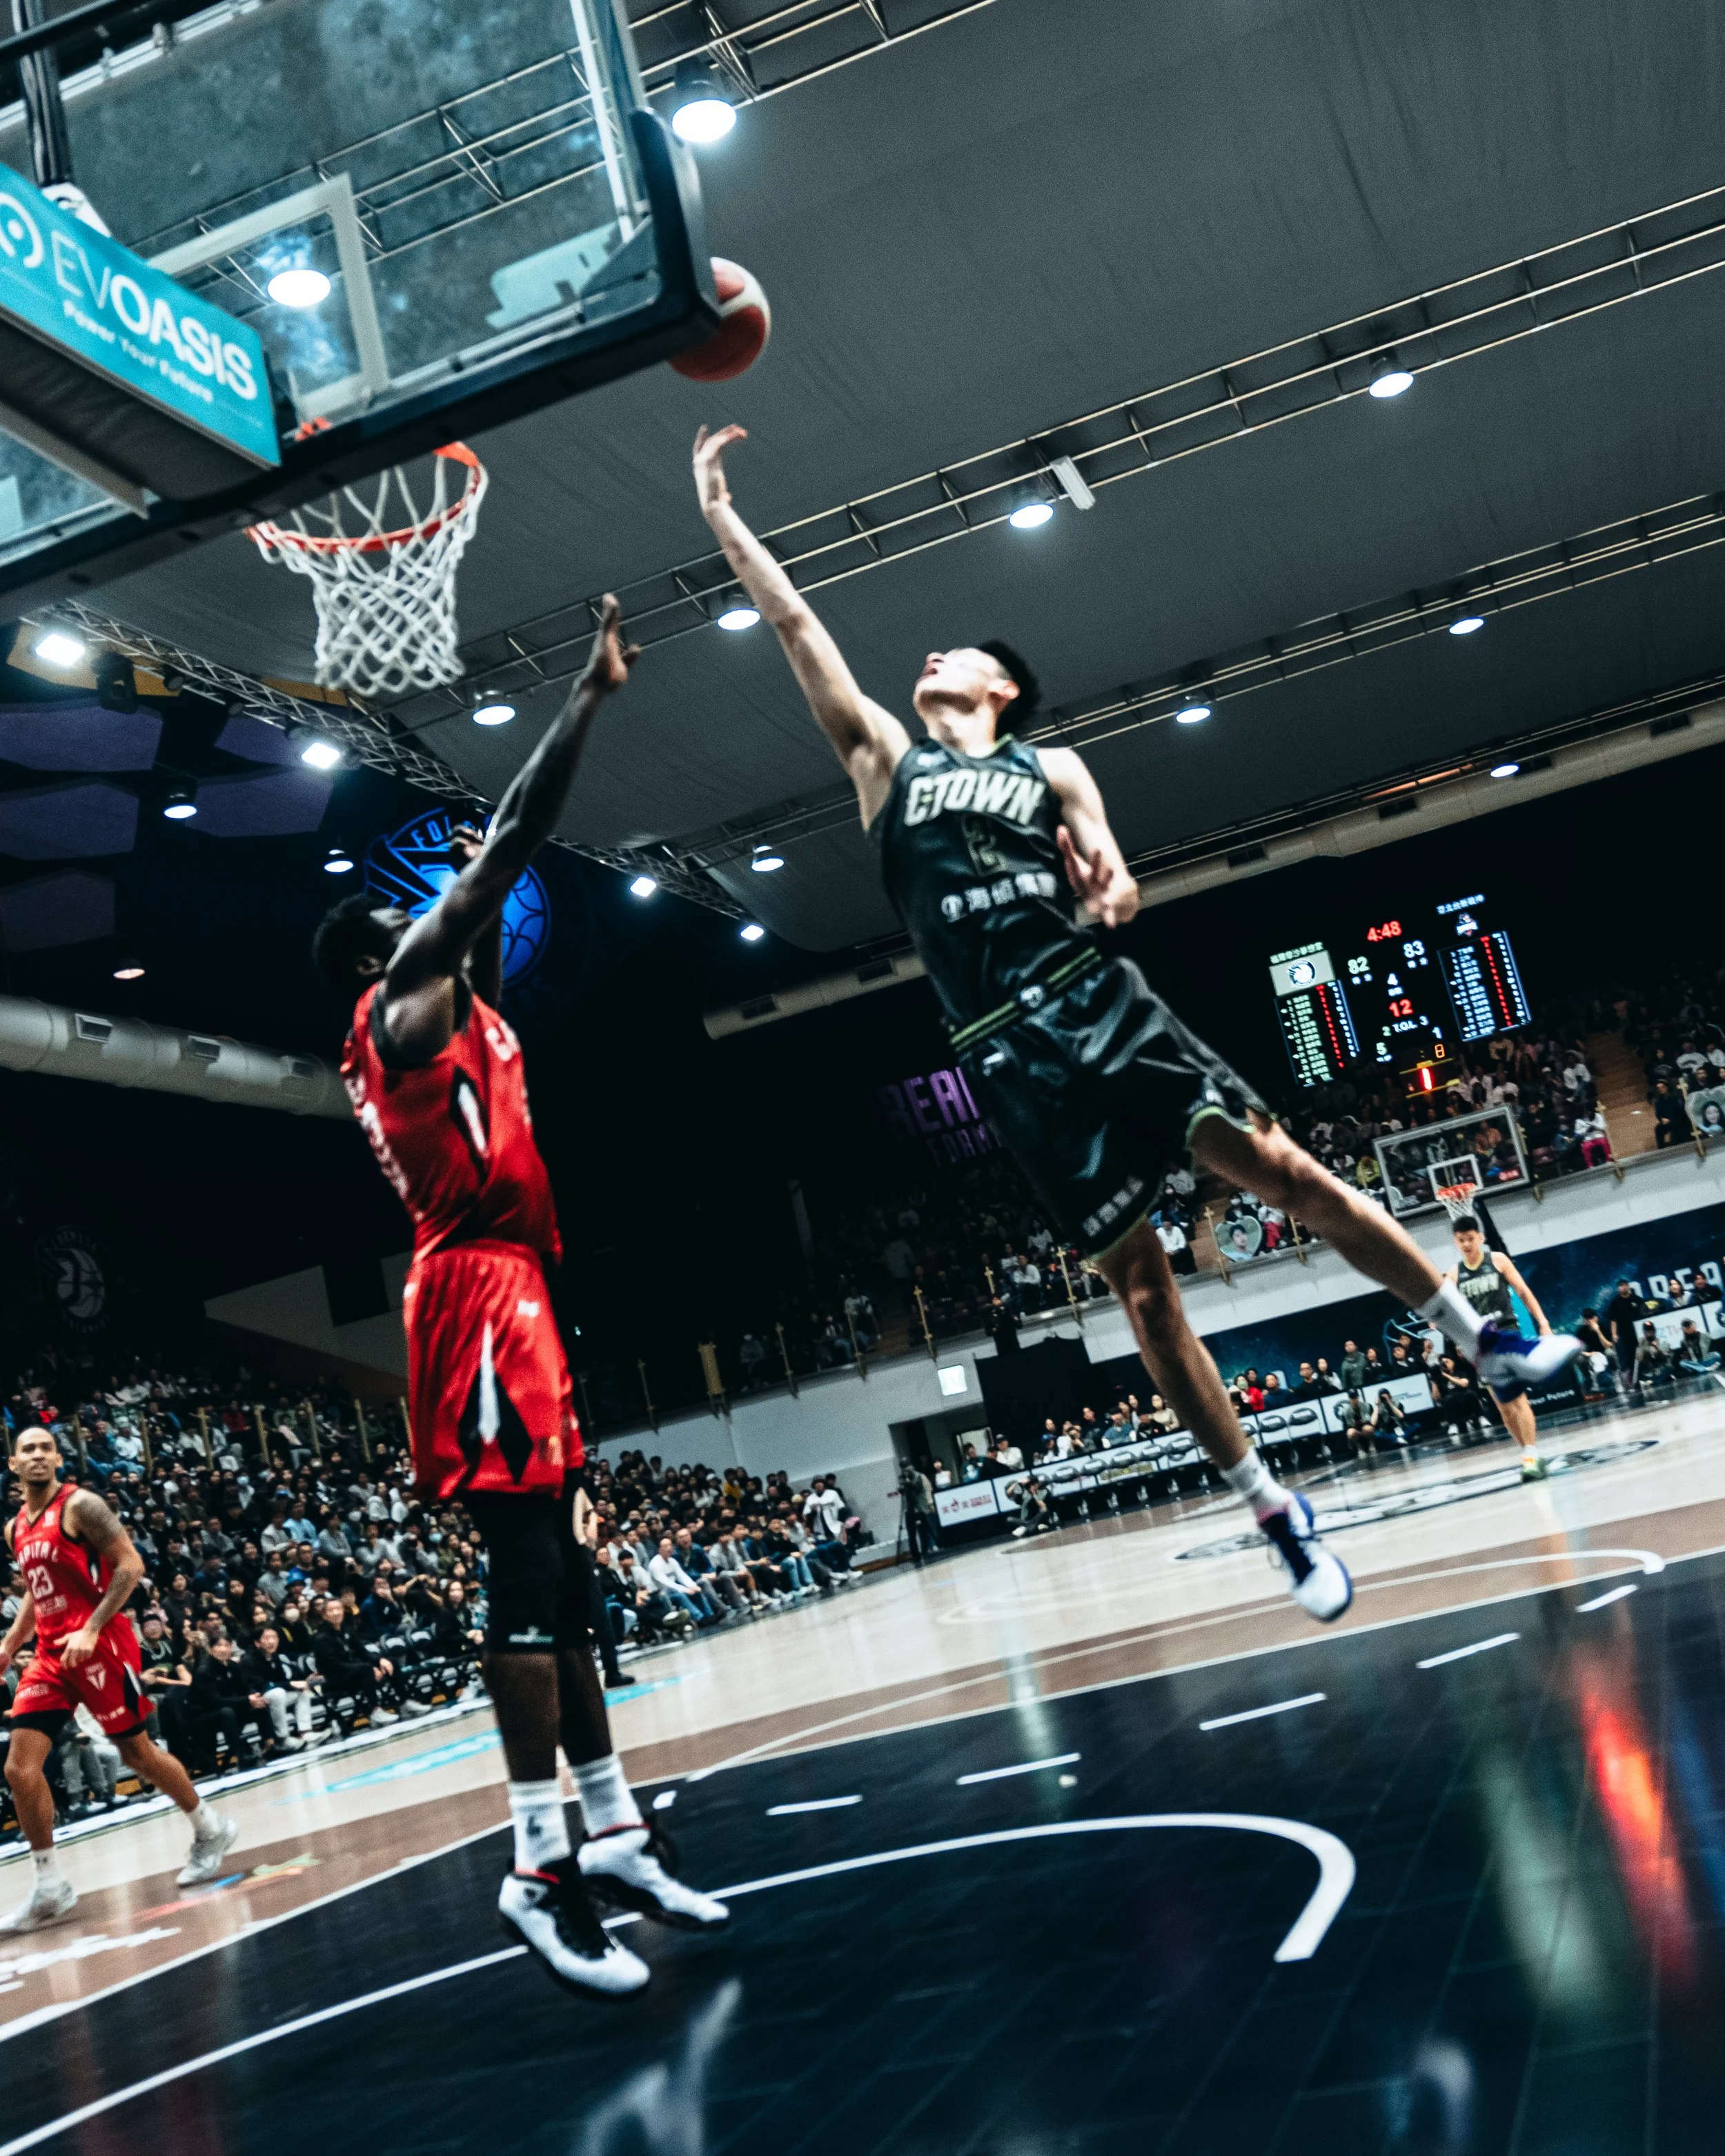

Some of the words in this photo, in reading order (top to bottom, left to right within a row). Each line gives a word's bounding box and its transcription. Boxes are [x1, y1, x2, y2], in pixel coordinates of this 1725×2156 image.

[51, 230, 257, 400] EVOASIS
[1367, 920, 1402, 942] 4:48
[1403, 940, 1426, 958] 83
[1348, 956, 1370, 974] 82
[1388, 999, 1414, 1018] 12
[1419, 1016, 1429, 1026] 3
[28, 1565, 54, 1599] 23
